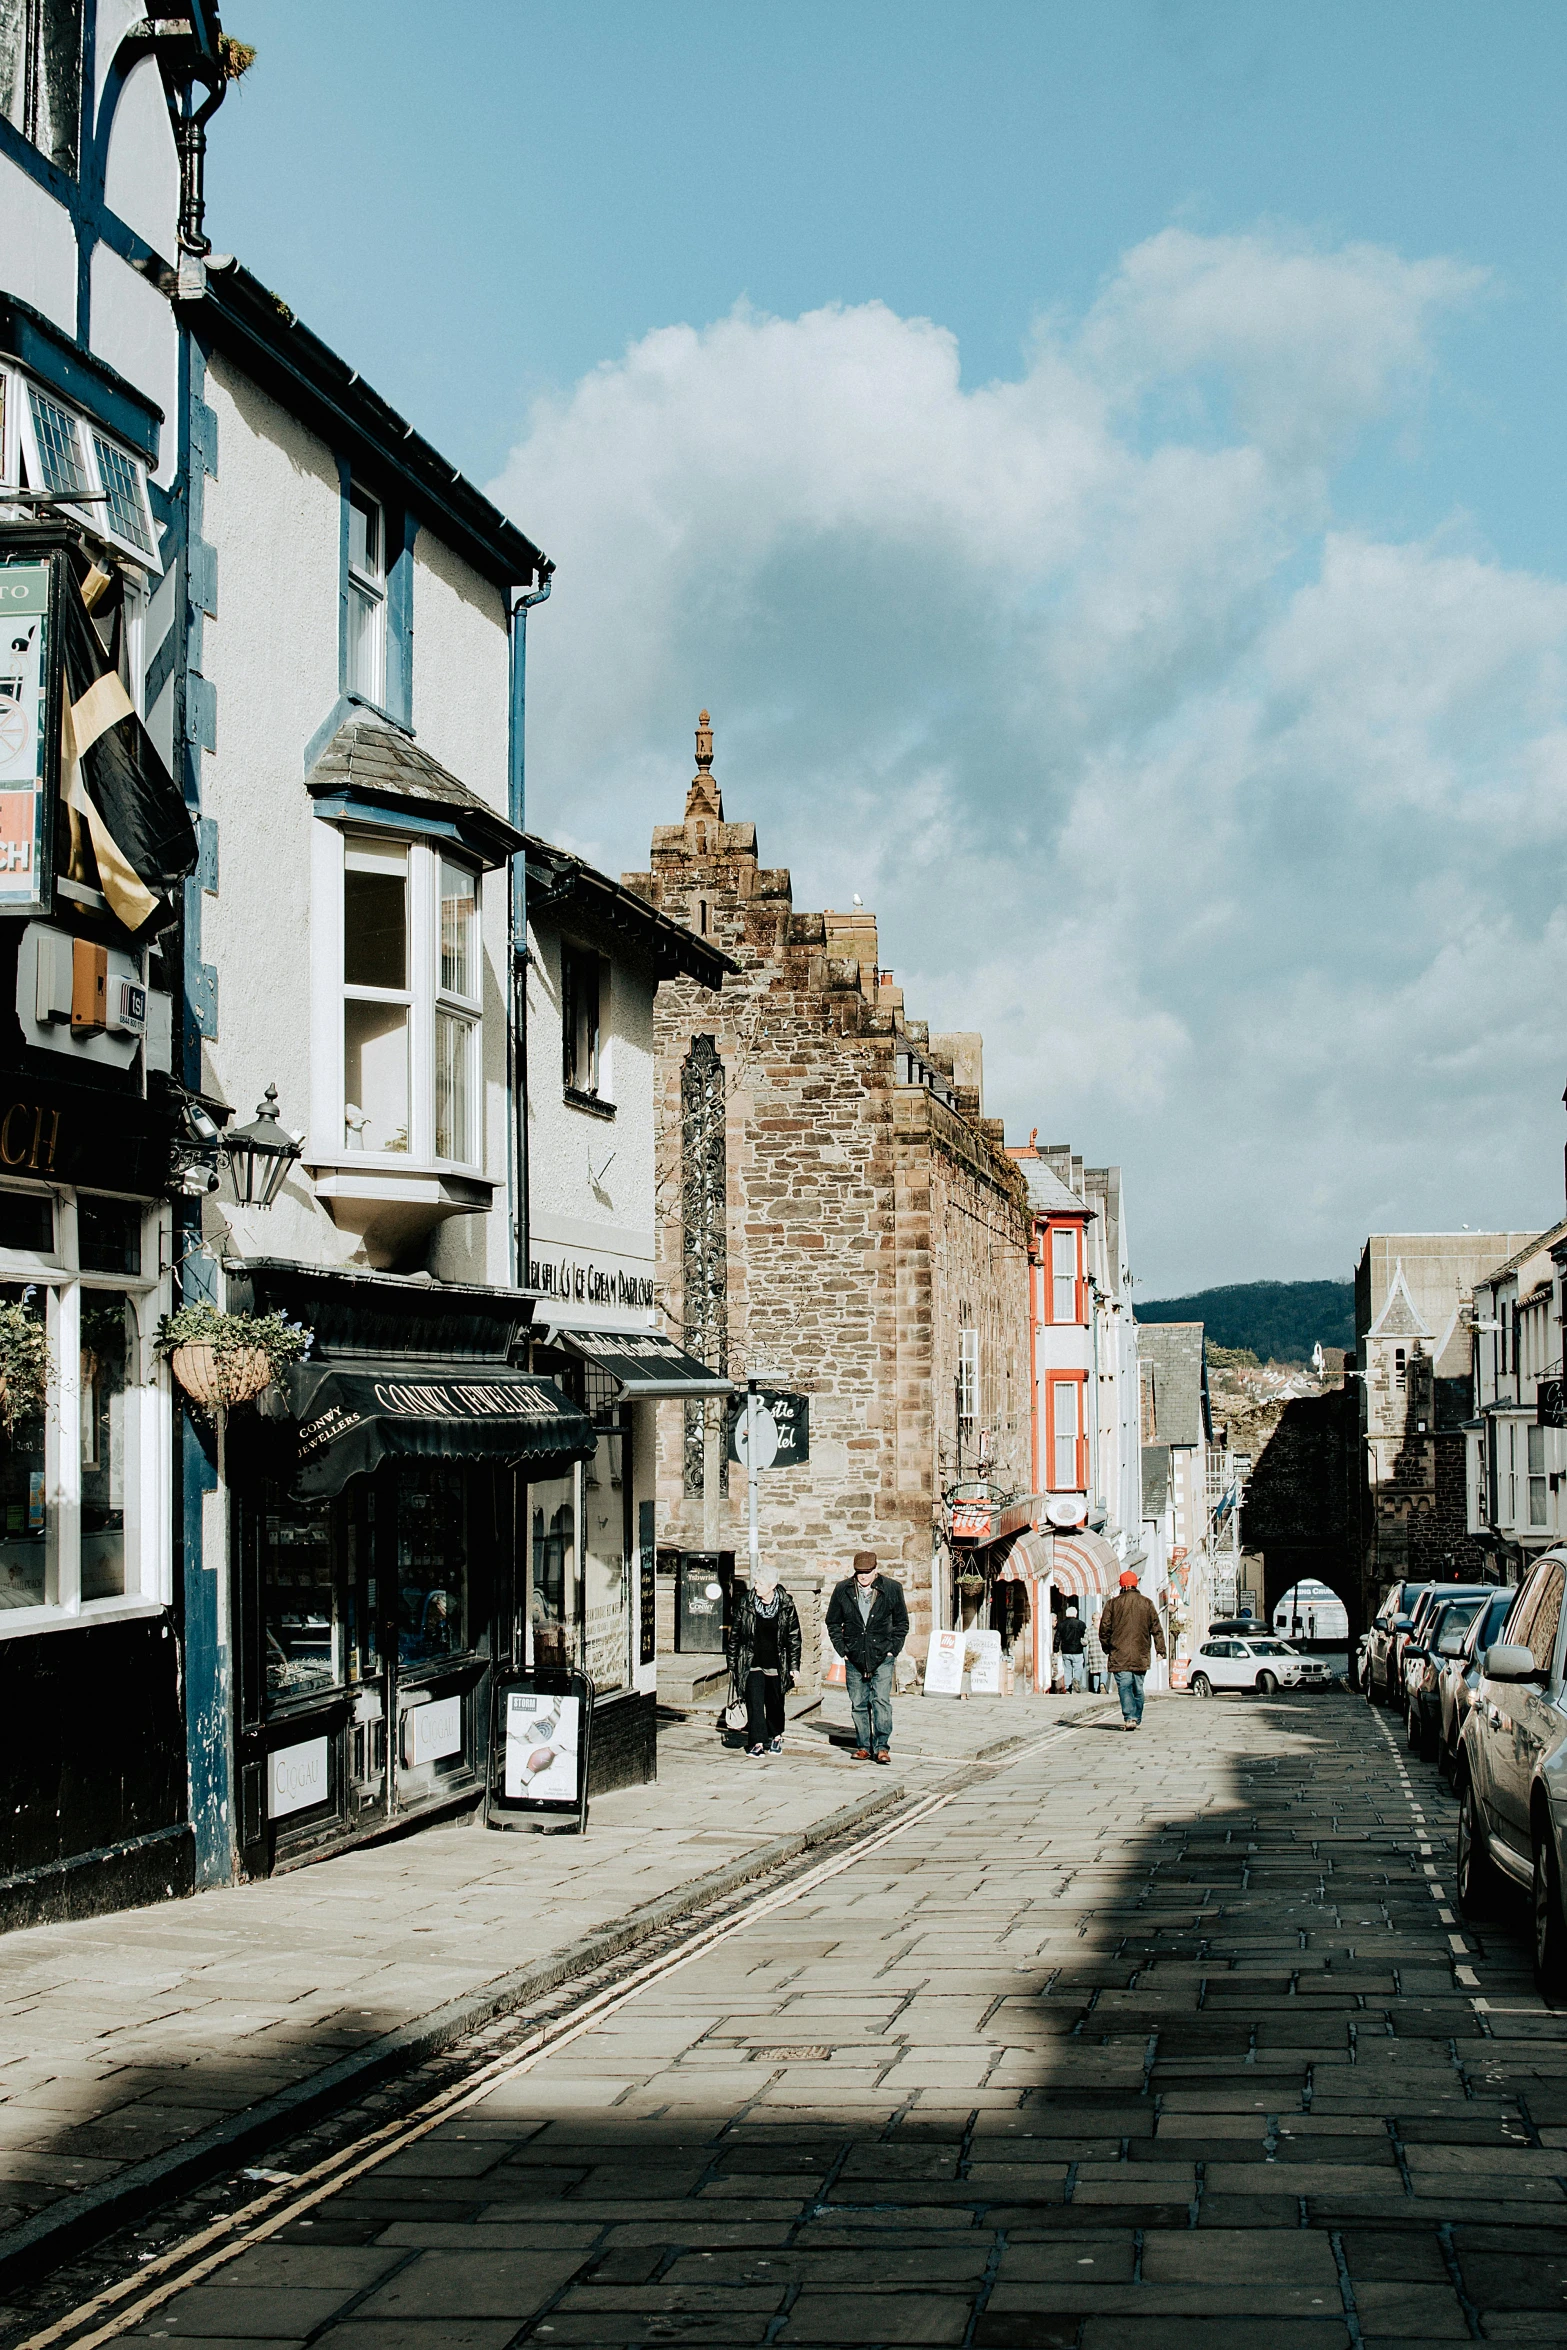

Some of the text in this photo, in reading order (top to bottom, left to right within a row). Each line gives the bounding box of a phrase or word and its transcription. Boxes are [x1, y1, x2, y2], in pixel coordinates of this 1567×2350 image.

[587, 1264, 617, 1303] CREAM
[618, 1269, 654, 1306] PARLOUR
[374, 1383, 559, 1416] CONWY JEWELLERS
[298, 1411, 361, 1458] JEWELLERS
[299, 1404, 343, 1439] CONWY
[777, 1424, 796, 1449] tel
[513, 1697, 536, 1708] STORM
[276, 1759, 319, 1799] CLOGAU
